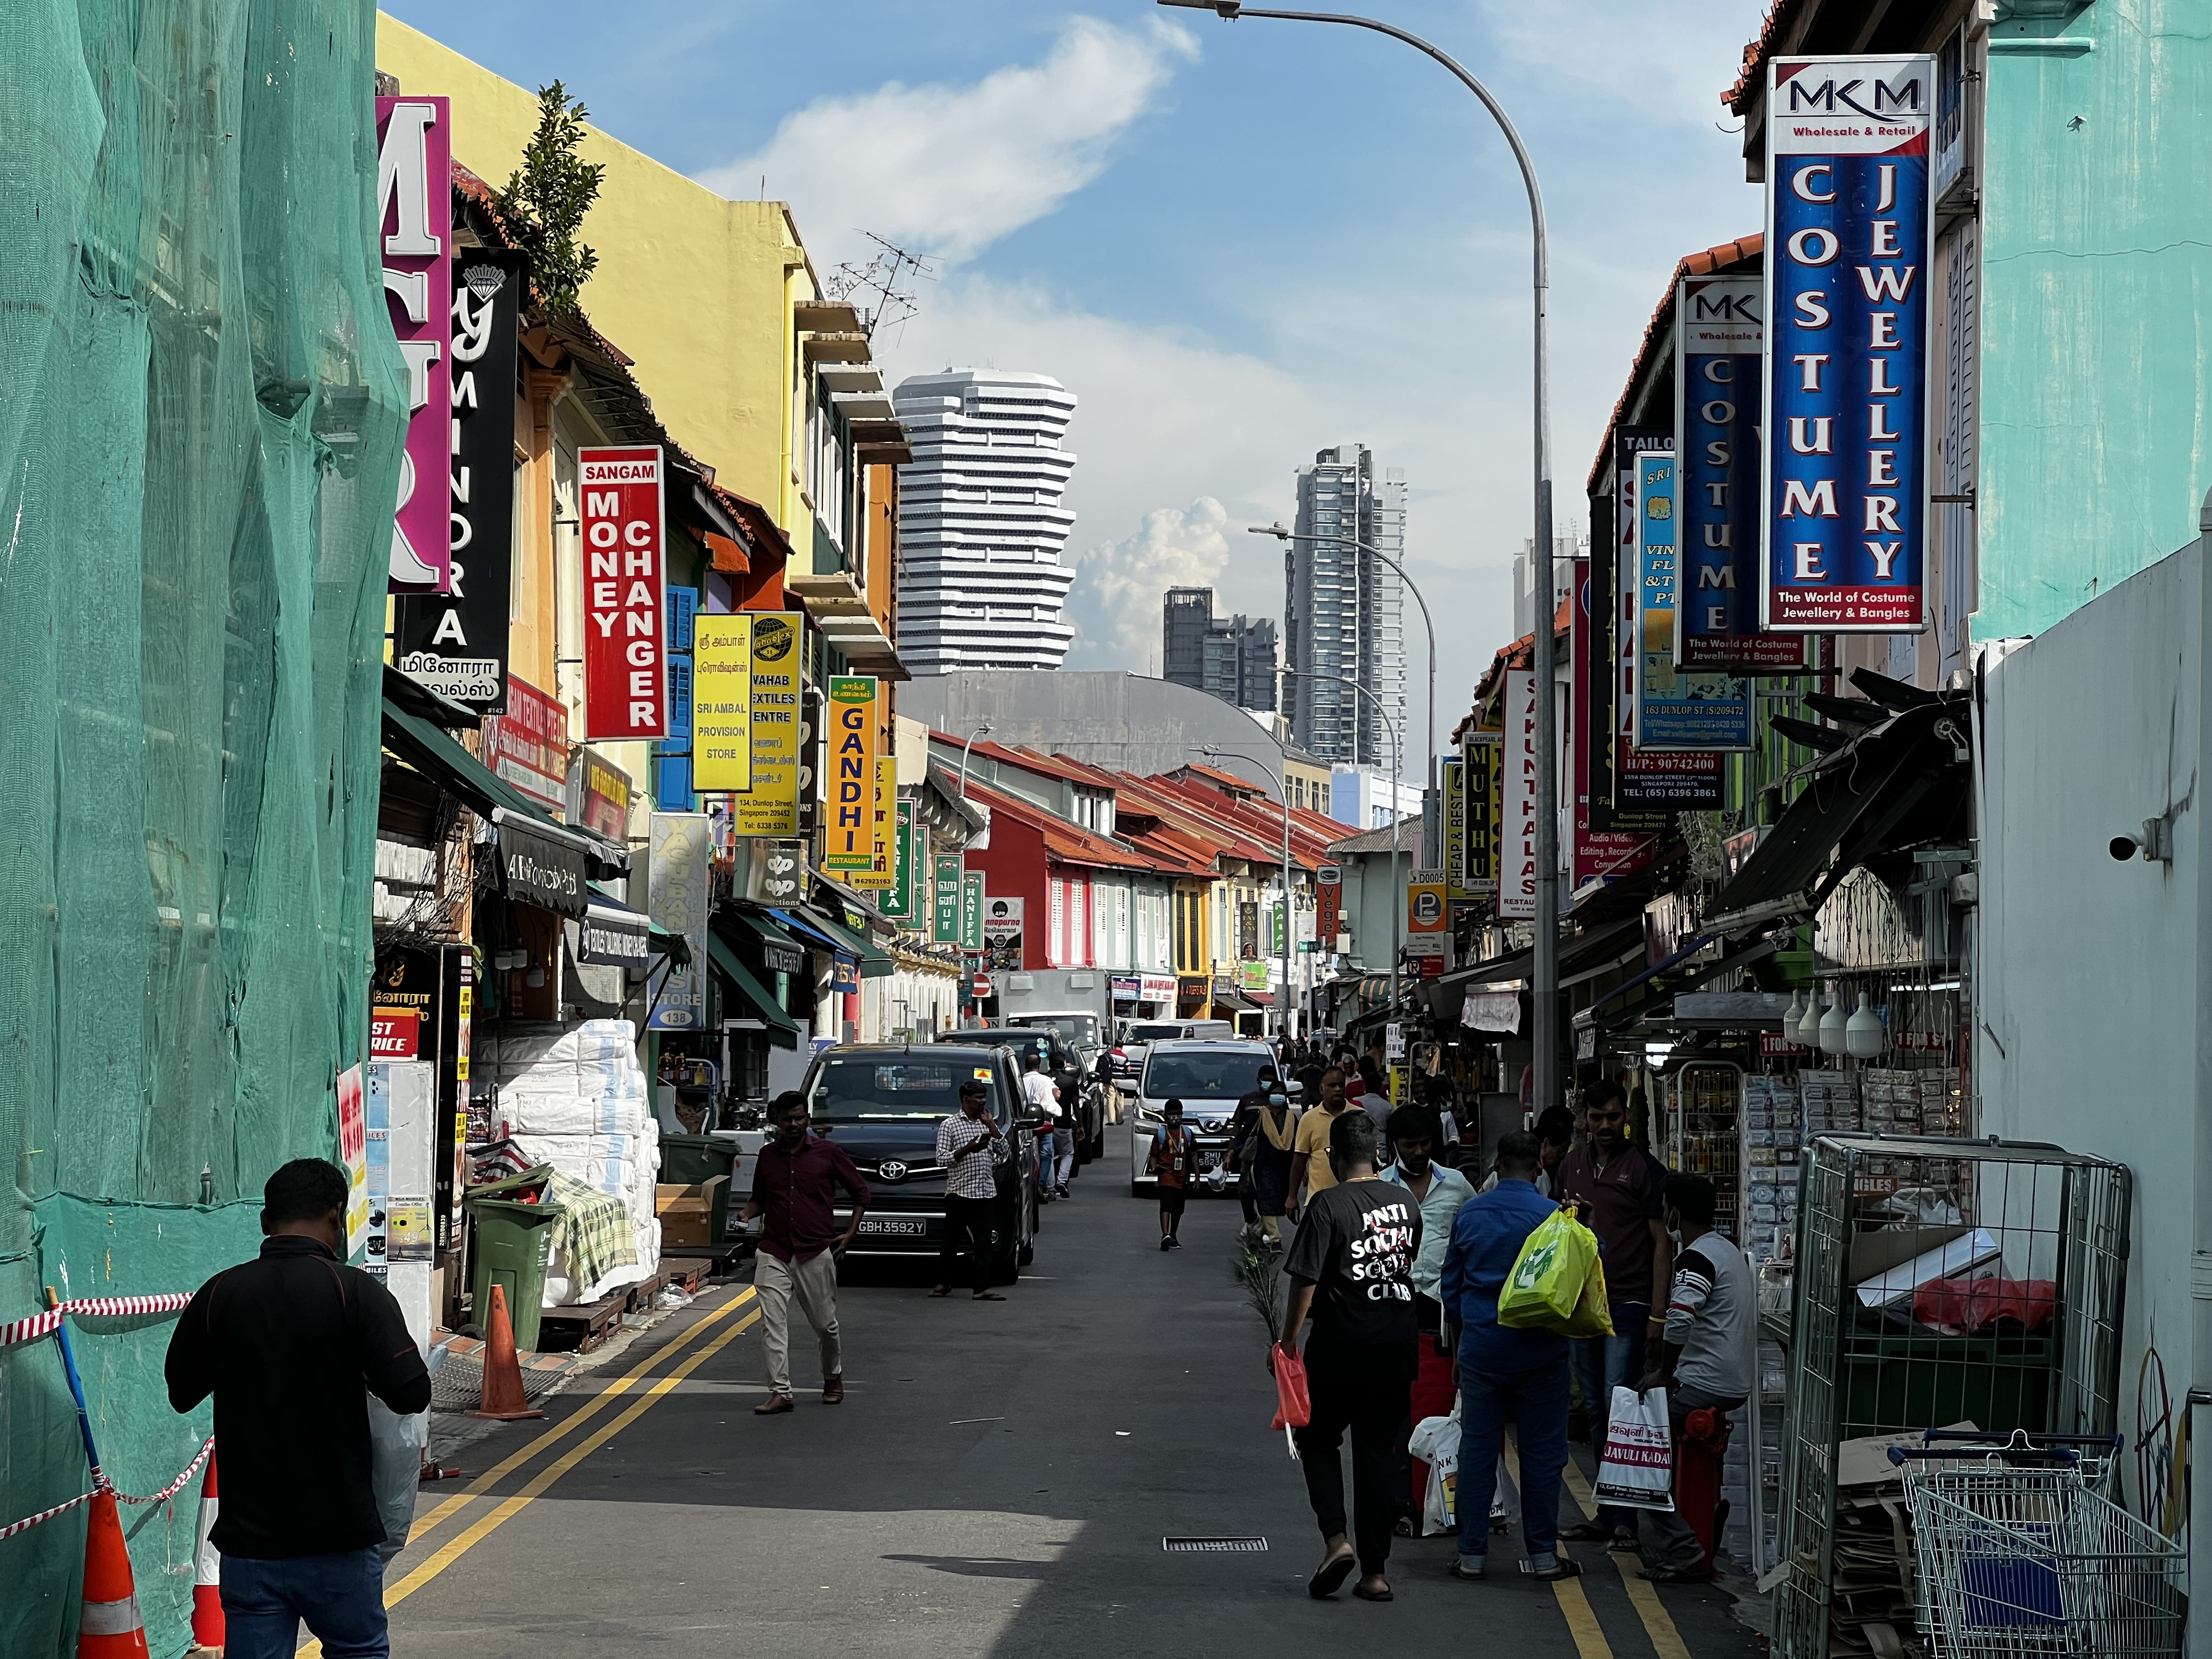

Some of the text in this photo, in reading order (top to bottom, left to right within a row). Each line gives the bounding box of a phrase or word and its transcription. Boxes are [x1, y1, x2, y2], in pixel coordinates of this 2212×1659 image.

[1790, 79, 1921, 123] MKM
[1793, 126, 1916, 137] Wholesale & Retail
[1699, 332, 1752, 340] Wholesale
[1855, 164, 1916, 581] JEWELLERY
[586, 466, 655, 480] SANGAM
[1646, 466, 1672, 486] SRI
[587, 492, 619, 638] MONEY
[1778, 591, 1915, 603] The World of Costume
[1782, 607, 1910, 620] Jewellery & Bangles
[624, 520, 658, 727] CHANGER
[1689, 639, 1798, 649] The World of Costume
[1693, 651, 1794, 663] Jewellery & Bangles
[697, 703, 747, 713] SRI AMBAL
[1646, 706, 1659, 714] 163
[1661, 706, 1692, 714] DUNLOP
[1693, 706, 1704, 714] ST
[698, 727, 745, 737] PROVISION
[707, 749, 737, 759] STORE
[1657, 759, 1714, 769] 90742400
[838, 707, 865, 852] GANDHI
[1646, 789, 1666, 798] (65)
[753, 800, 774, 808] Dunlop
[739, 809, 769, 817] Singapore
[1469, 747, 1488, 877] MUTHU
[1589, 833, 1609, 842] Audio
[1323, 887, 1334, 932] Vege
[966, 888, 975, 946] HANIFFA
[651, 993, 702, 1006] STORE
[665, 1013, 687, 1023] 138
[1361, 1203, 1408, 1232] ANTI
[859, 1221, 924, 1233] GBH3592Y
[1367, 1282, 1411, 1301] CLUB
[1604, 1446, 1671, 1464] JAVULI KADAI
